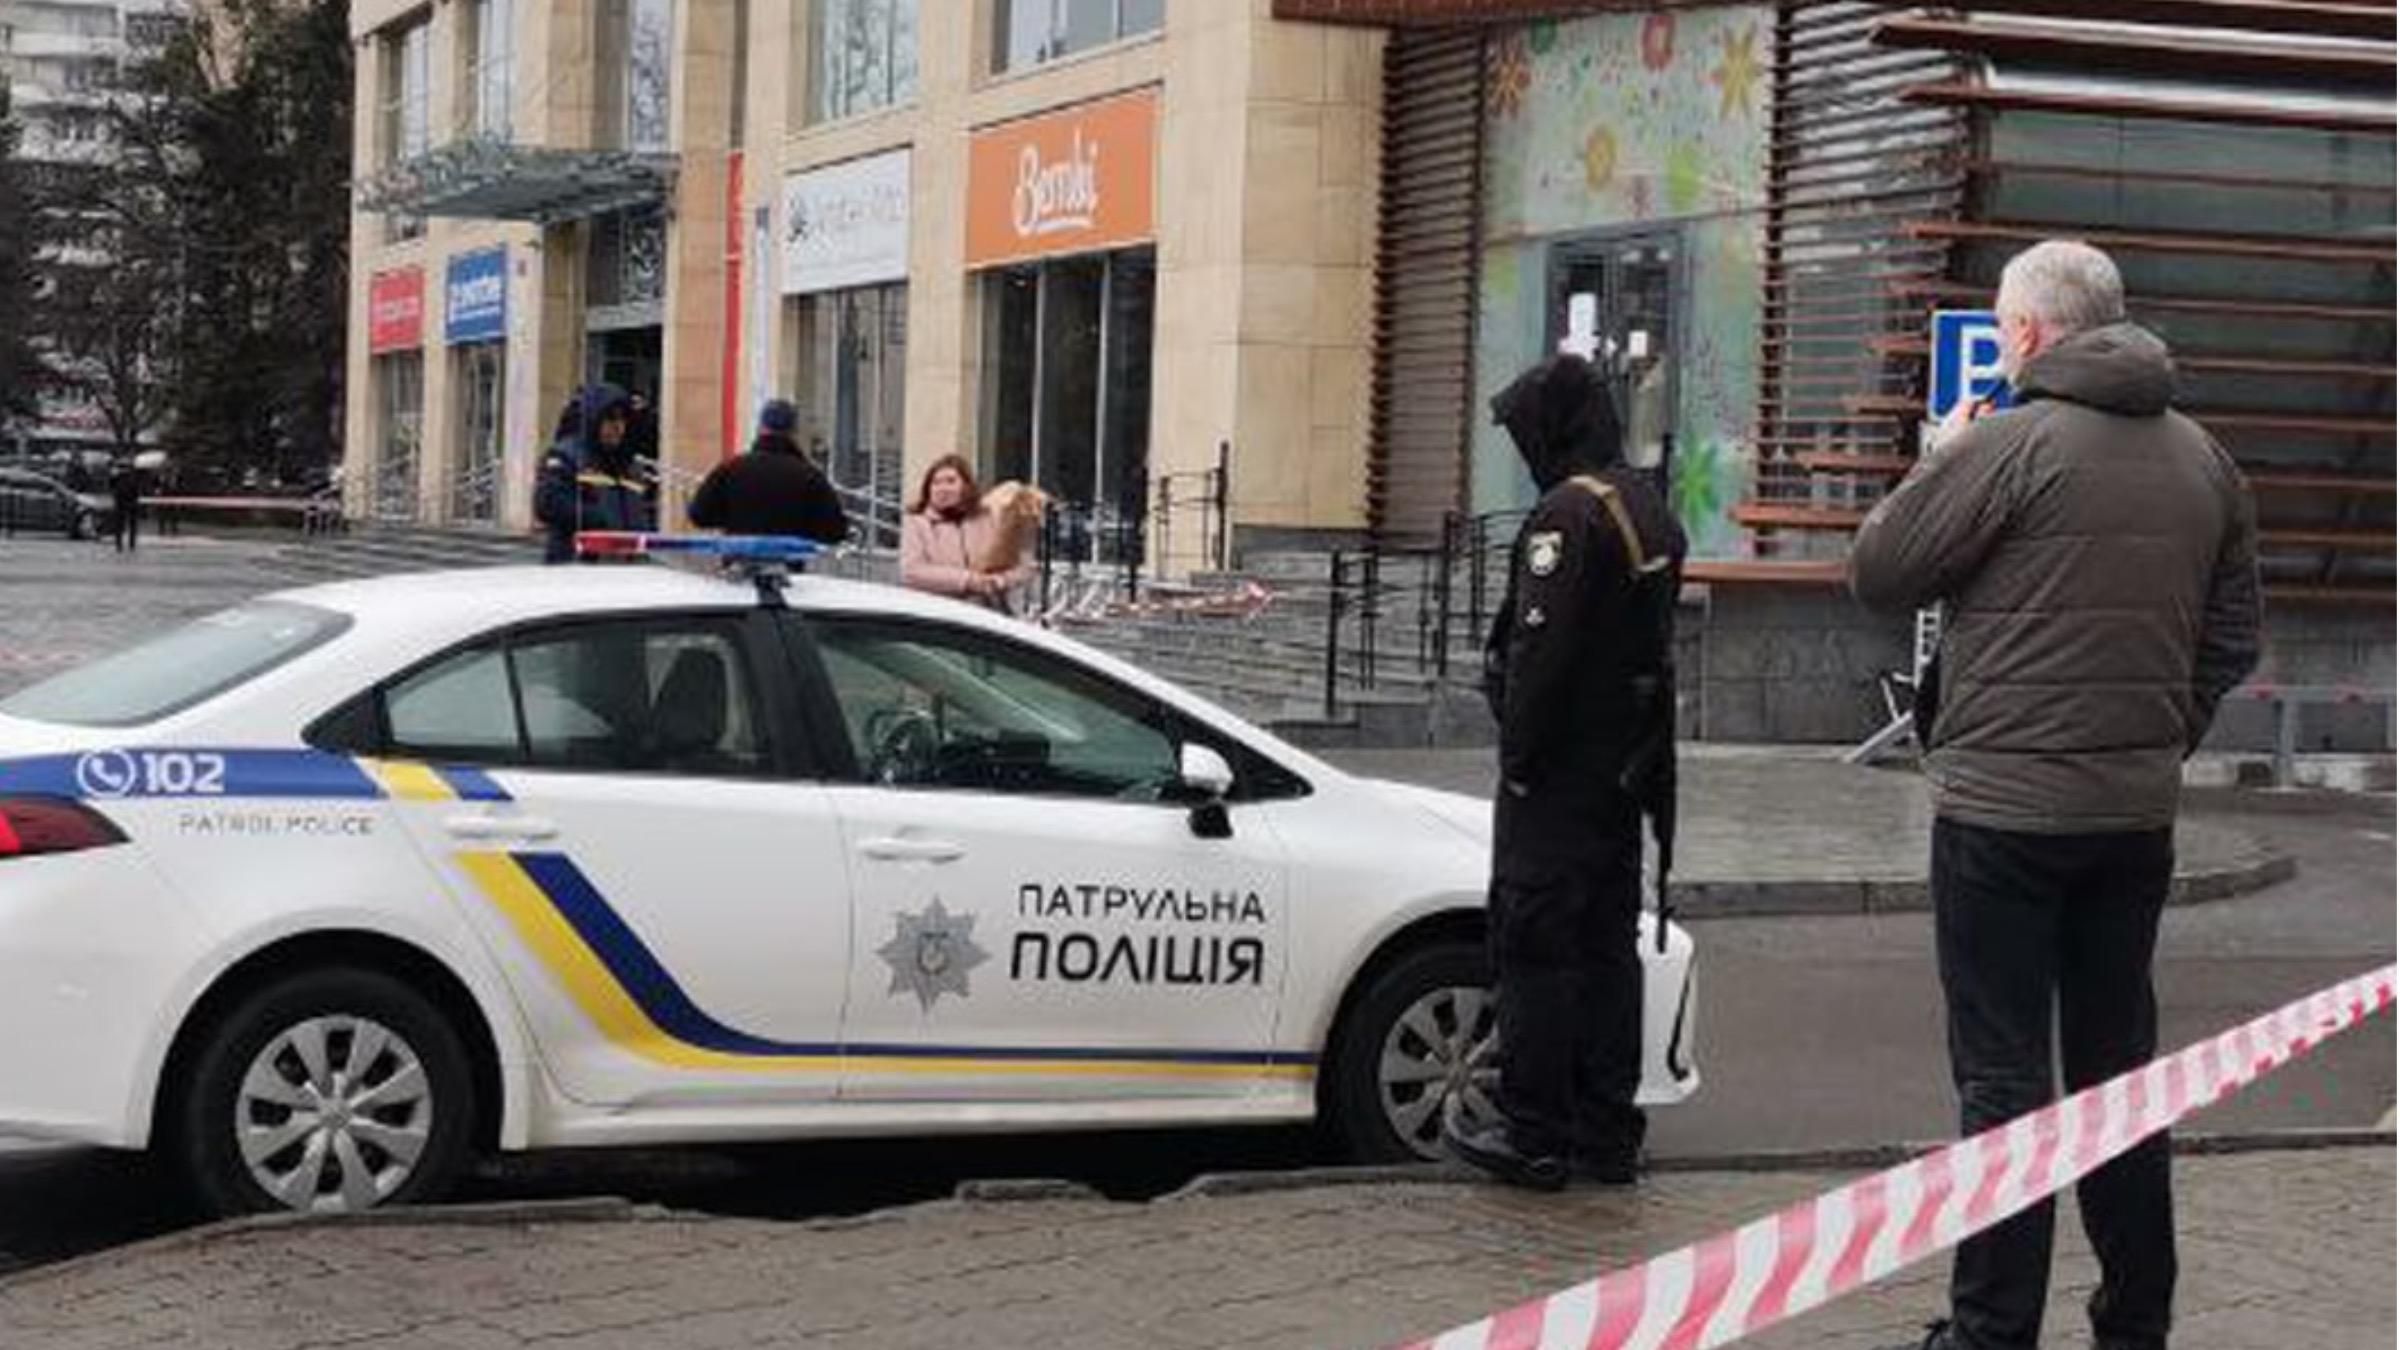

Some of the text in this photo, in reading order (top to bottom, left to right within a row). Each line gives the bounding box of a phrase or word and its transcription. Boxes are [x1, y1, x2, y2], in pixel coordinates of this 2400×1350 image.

[1959, 324, 2004, 403] P
[142, 752, 226, 793] 102
[178, 813, 374, 837] PATROL POLICE
[1018, 884, 1266, 923] ПАТРУЛЬНА
[1009, 931, 1265, 985] ПОЛІЦІЯ
